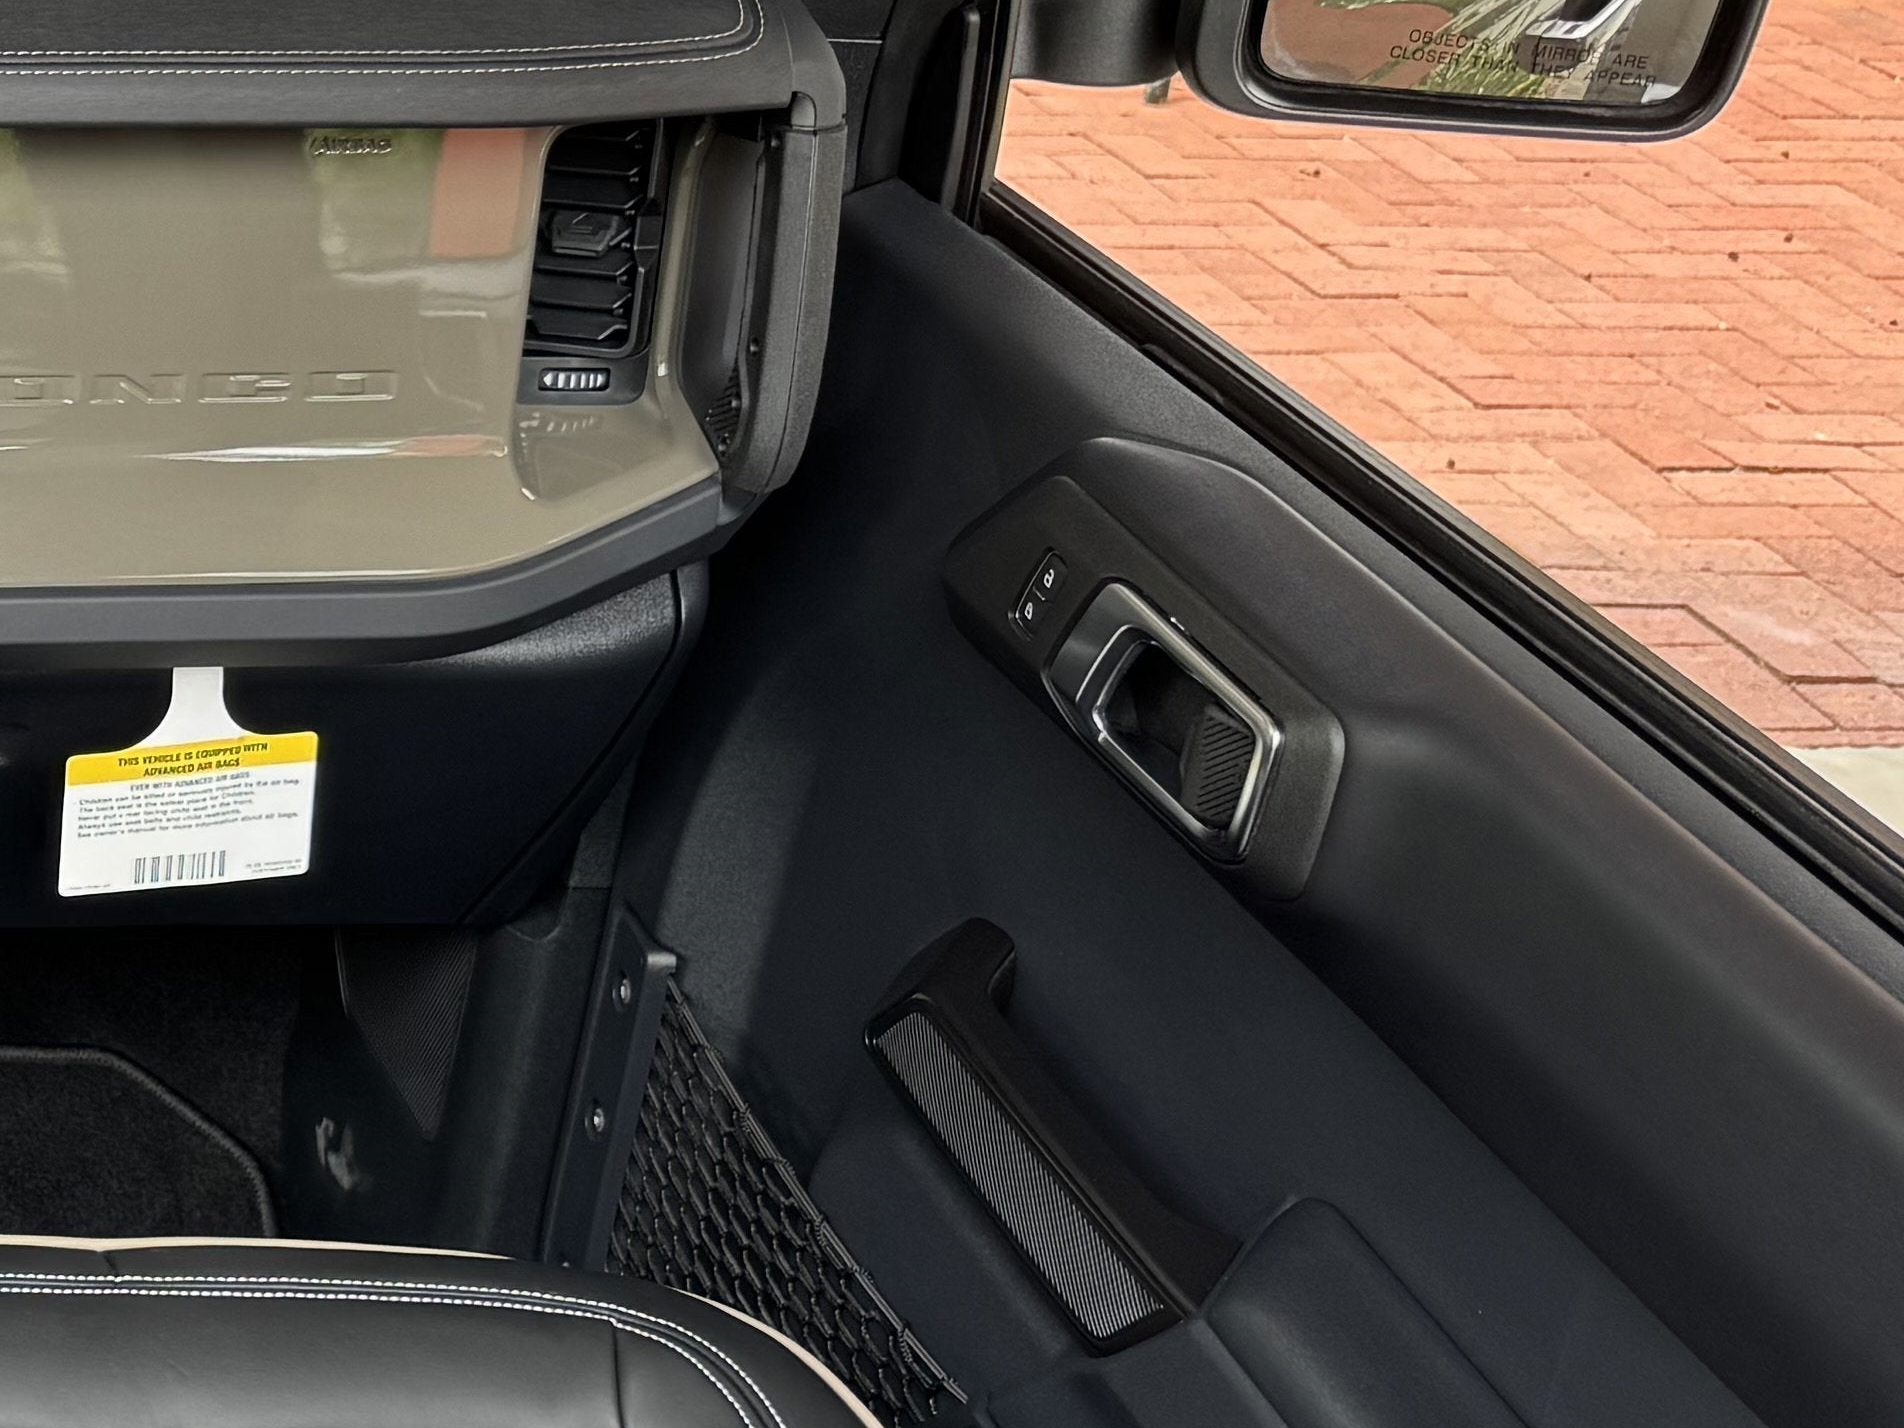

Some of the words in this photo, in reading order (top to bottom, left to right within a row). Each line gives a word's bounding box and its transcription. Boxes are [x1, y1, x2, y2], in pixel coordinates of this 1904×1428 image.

[1409, 29, 1490, 52] OBJECTS
[1503, 39, 1519, 54] IN
[1531, 42, 1598, 64] MIRROR
[1612, 53, 1649, 69] ARE
[1389, 45, 1461, 66] CLOSER
[1472, 55, 1520, 73] THAN
[1532, 62, 1574, 80] THEY
[1584, 70, 1657, 88] APPEAR
[118, 757, 139, 767] THIS
[142, 752, 182, 764] VEHICLE
[184, 752, 193, 760] IS
[196, 746, 242, 759] EQUIPPED
[243, 742, 268, 752] WITH
[143, 764, 195, 777] ADVANCED
[196, 761, 213, 771] AIR
[215, 758, 240, 768] BAGS
[130, 784, 150, 792] EVEN
[174, 777, 214, 787] ADVANCED
[215, 774, 228, 782] AIR
